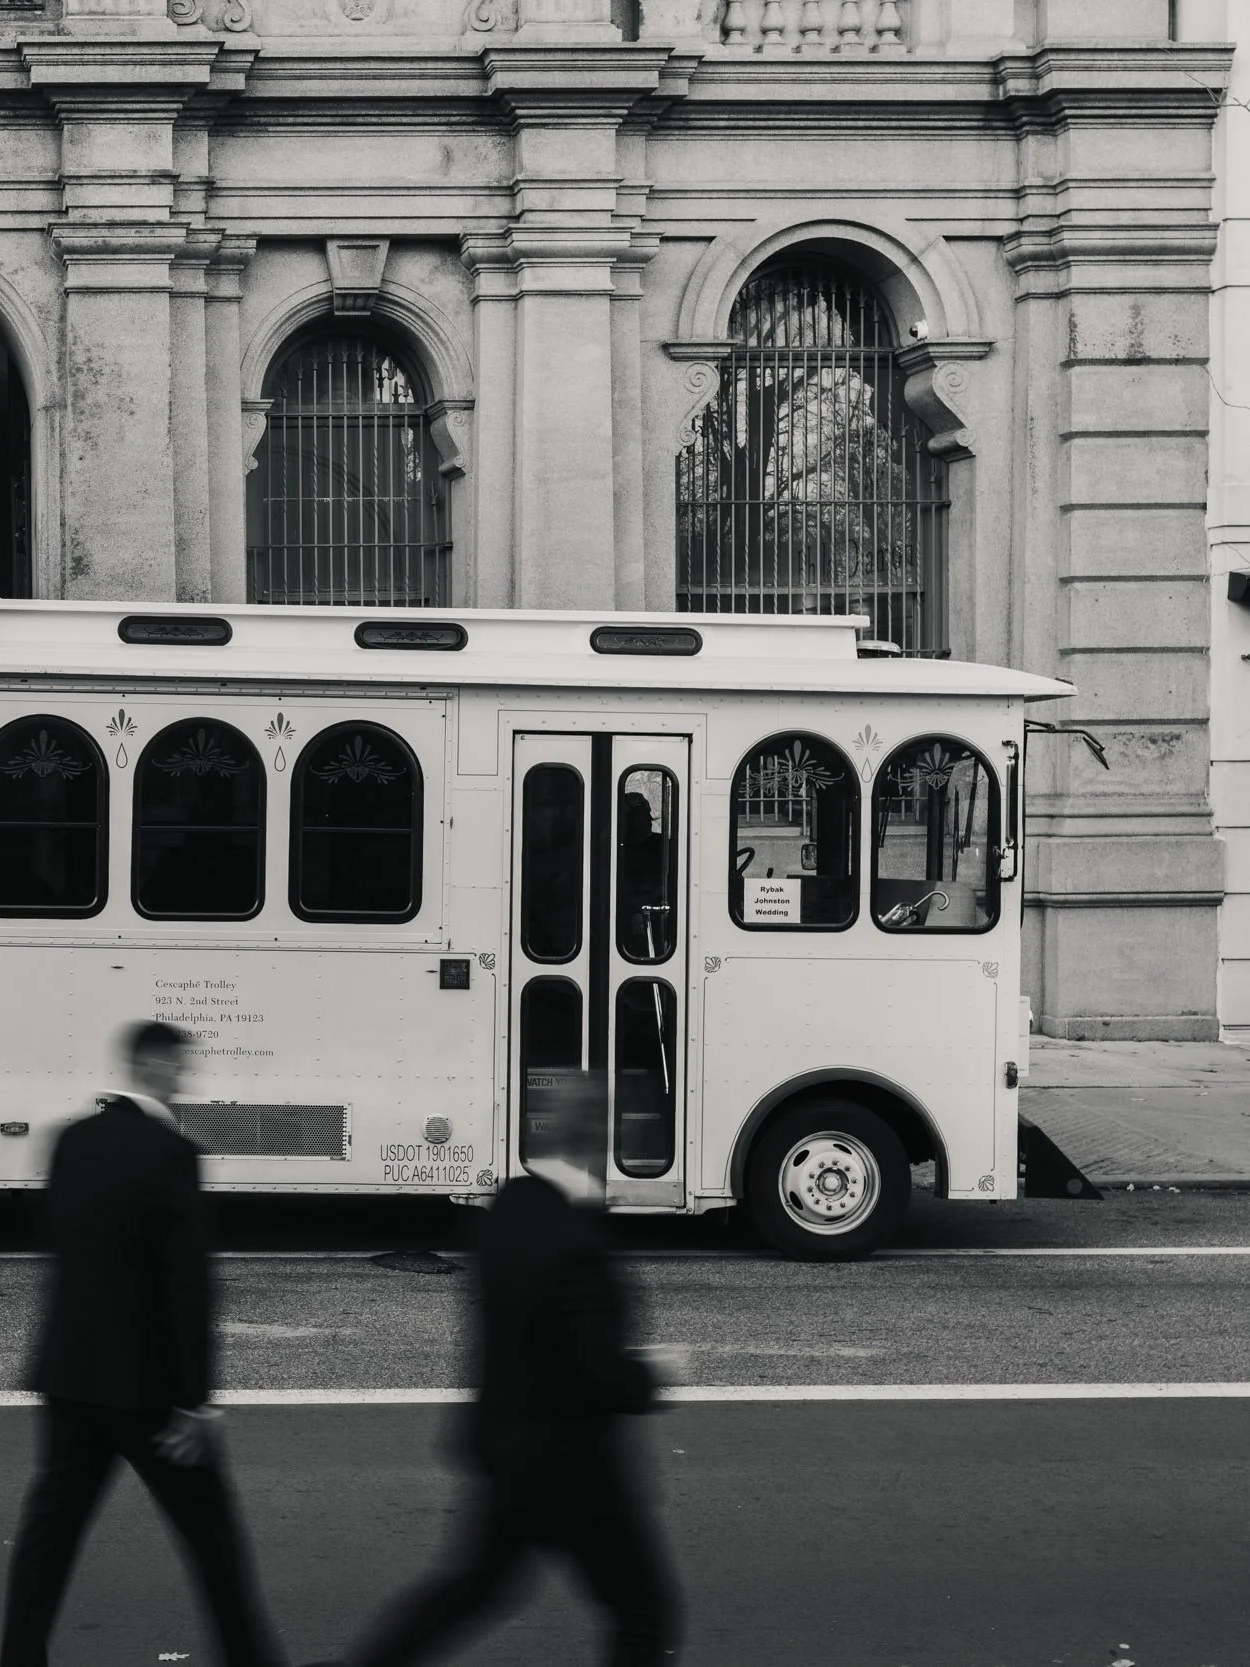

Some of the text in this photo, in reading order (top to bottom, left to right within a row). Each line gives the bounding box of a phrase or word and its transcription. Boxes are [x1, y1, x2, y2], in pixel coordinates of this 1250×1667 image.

[755, 909, 789, 917] Wedding
[155, 980, 237, 991] Cescaphé Trolley
[155, 996, 238, 1006] 923 N. 2nd Street
[155, 1013, 264, 1024] Philadelphia, PA 19123
[380, 1144, 474, 1162] USDOT 1901650
[383, 1164, 469, 1183] PUC A6411025
